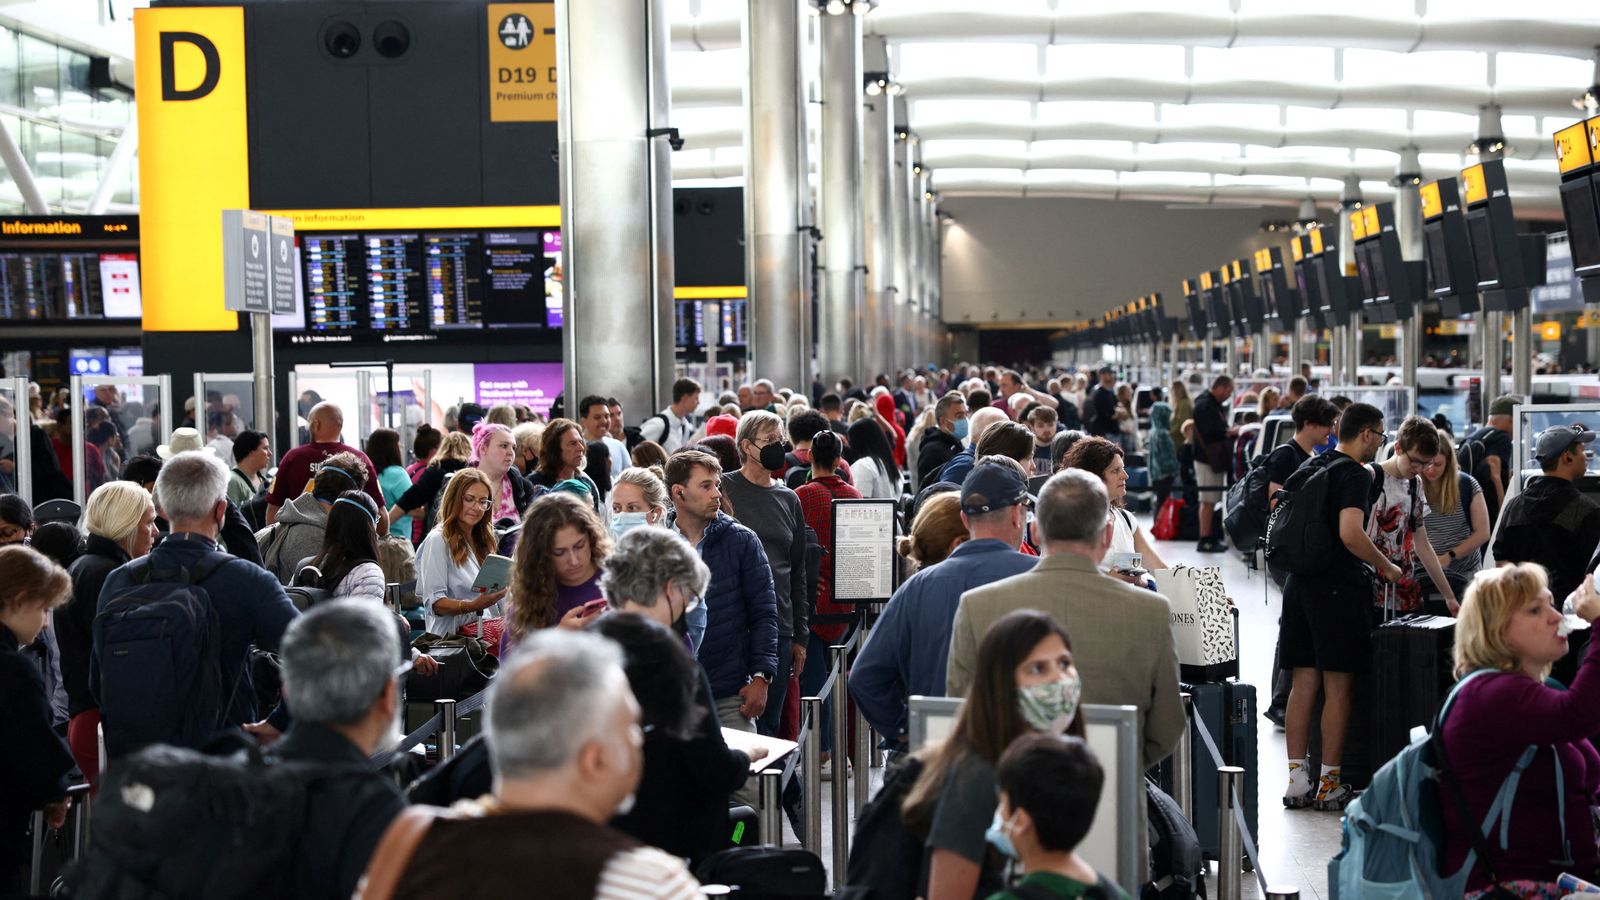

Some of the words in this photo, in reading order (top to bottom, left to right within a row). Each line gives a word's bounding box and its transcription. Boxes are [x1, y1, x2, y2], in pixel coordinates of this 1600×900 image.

[160, 31, 221, 101] D
[498, 67, 536, 84] D19
[496, 90, 543, 101] Premium
[304, 212, 365, 222] information
[2, 220, 81, 234] Information
